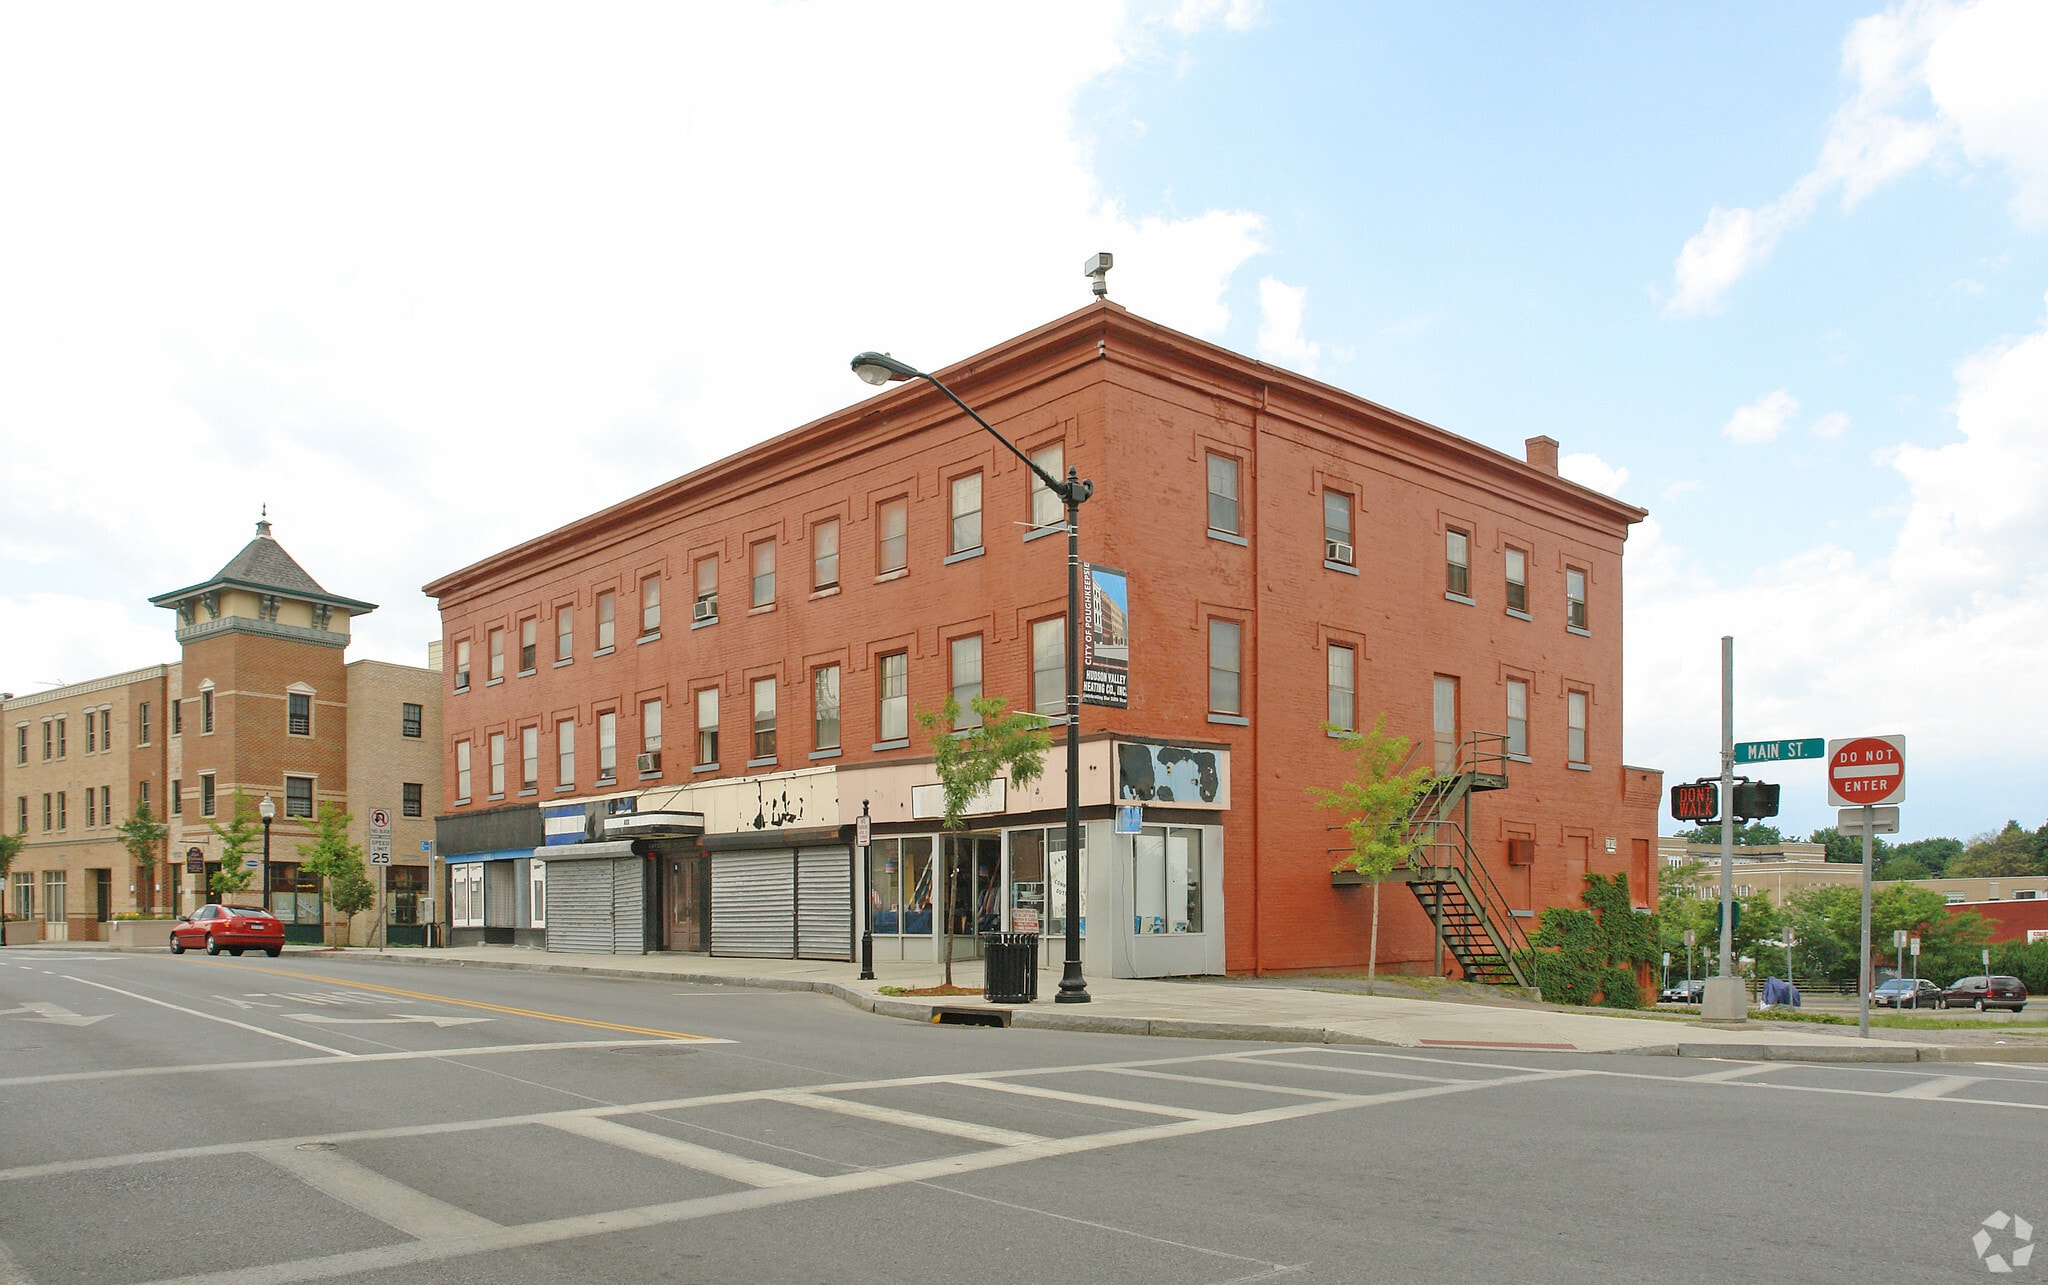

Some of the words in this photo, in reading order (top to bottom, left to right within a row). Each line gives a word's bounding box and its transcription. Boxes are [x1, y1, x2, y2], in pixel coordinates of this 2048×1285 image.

[1083, 562, 1092, 629] POUGHKEEPSIE
[1084, 629, 1092, 643] OF
[1084, 644, 1092, 665] CITY
[1086, 669, 1108, 682] HUDSON
[1107, 673, 1127, 685] VALLEY
[1083, 681, 1105, 694] HEATING
[1748, 743, 1779, 759] MAIN
[1788, 742, 1808, 758] ST.
[1840, 752, 1858, 763] DO
[1866, 749, 1893, 761] NOT
[1845, 779, 1888, 792] ENTER
[1679, 801, 1713, 817] WALK
[372, 852, 390, 863] 25
